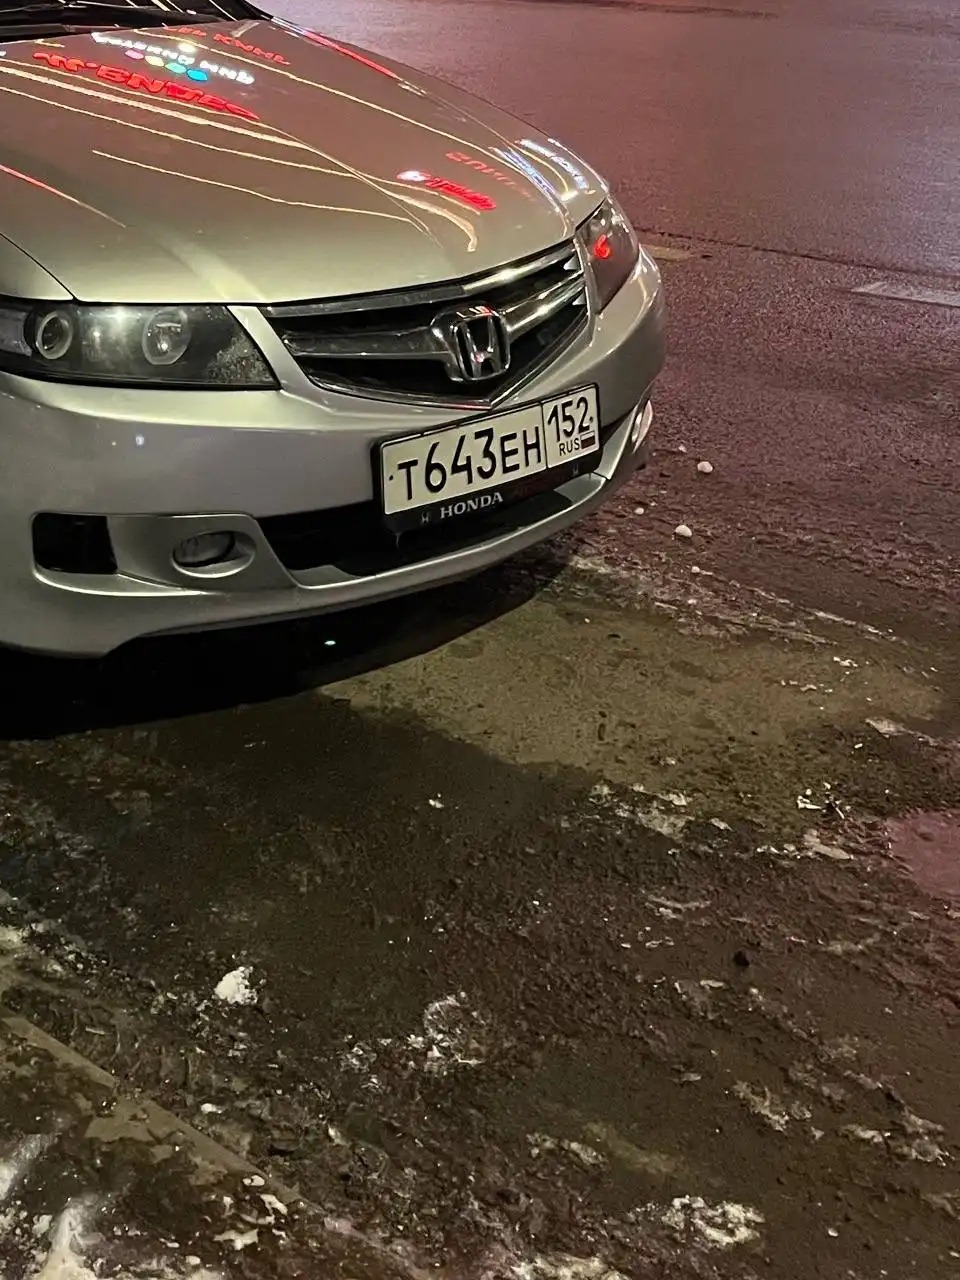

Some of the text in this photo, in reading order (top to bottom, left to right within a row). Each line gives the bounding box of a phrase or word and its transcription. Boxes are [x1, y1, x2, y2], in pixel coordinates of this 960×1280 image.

[397, 397, 591, 501] Т643ЕН 152
[559, 437, 581, 457] RUS
[440, 492, 503, 519] HONDA
